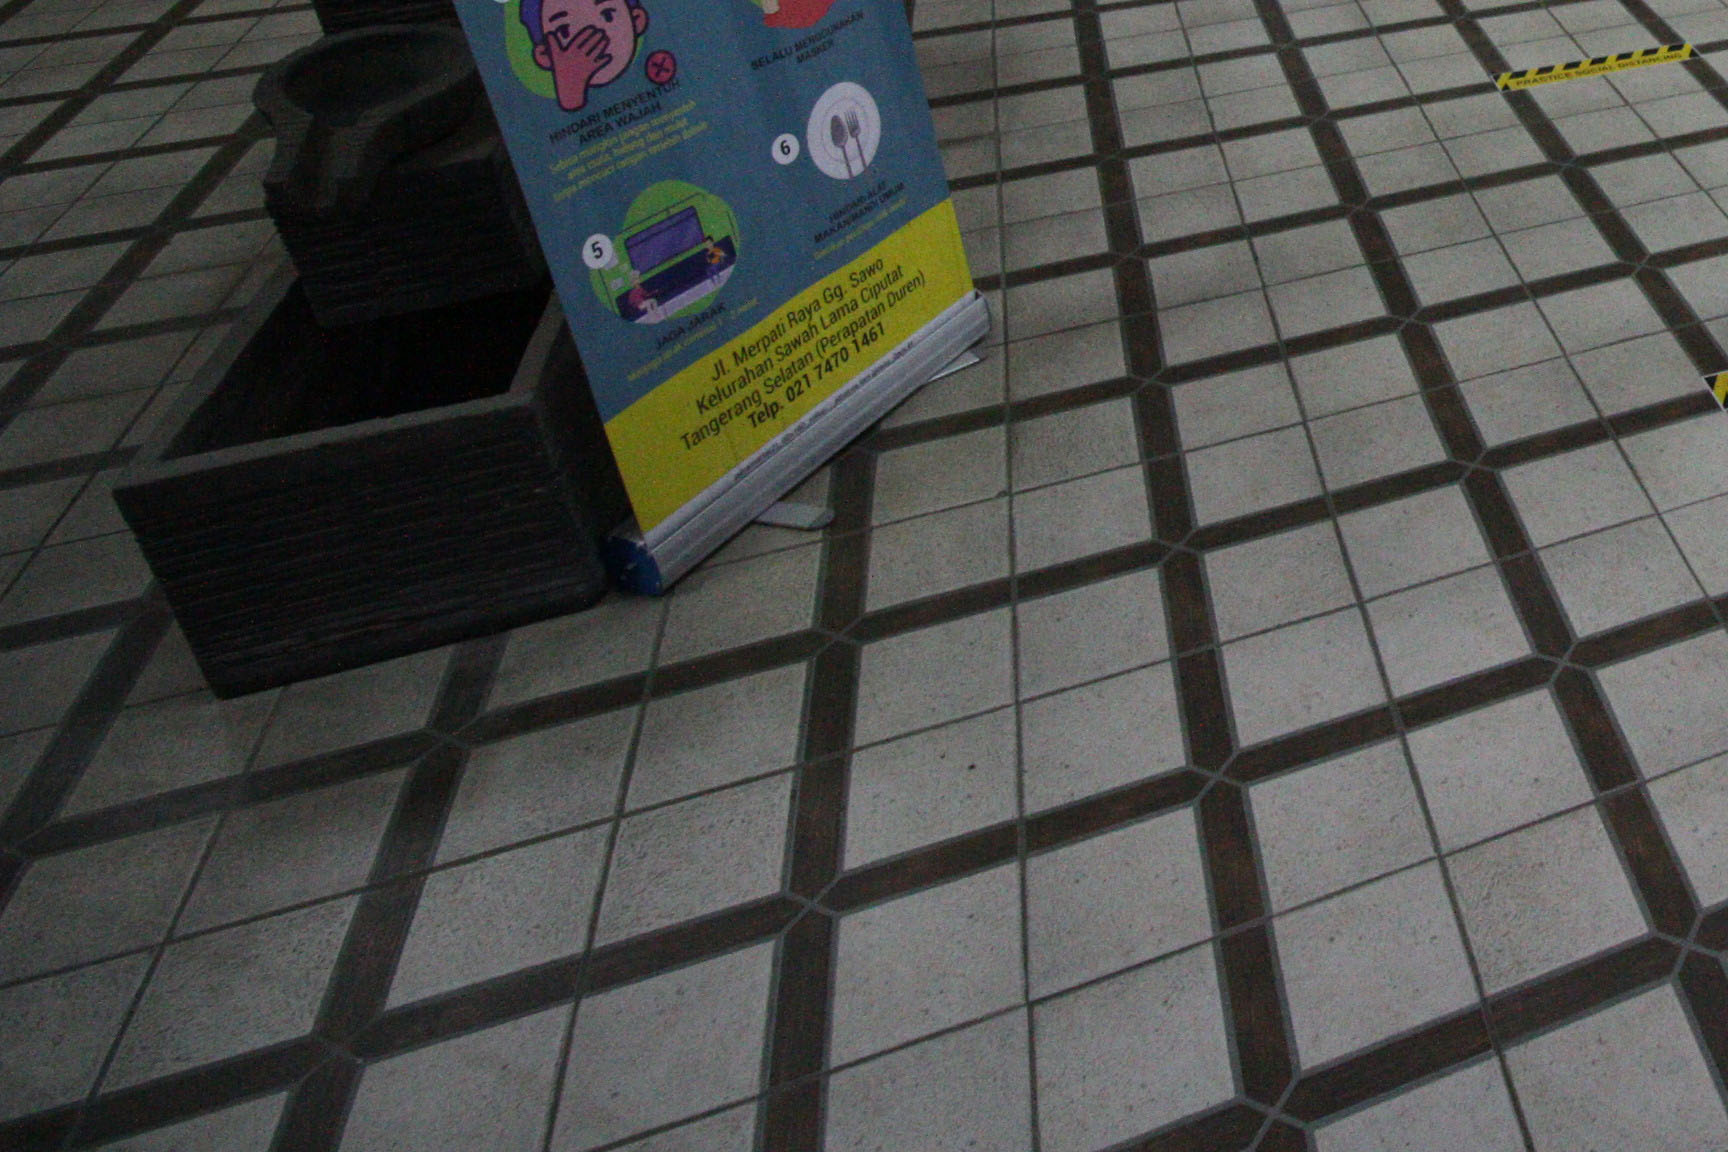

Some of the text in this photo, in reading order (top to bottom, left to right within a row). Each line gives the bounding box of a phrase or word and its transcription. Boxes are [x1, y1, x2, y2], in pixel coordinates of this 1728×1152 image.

[549, 112, 601, 145] HINDARI
[580, 102, 661, 144] AREA WAJAH
[780, 139, 791, 156] 6
[591, 242, 604, 259] 5
[695, 356, 774, 416] Kelurahan
[774, 323, 819, 370] Sawah
[820, 300, 860, 336] Lama
[860, 264, 905, 310] Ciputat
[711, 257, 884, 382] Jl. Merpati Raya Gg. Sawo
[680, 390, 762, 451] Tangerang
[764, 353, 814, 395] Selatan
[815, 303, 887, 363] (Perapatan
[887, 270, 926, 311] Duren)
[747, 322, 887, 430] Telp. 021 7470 1461
